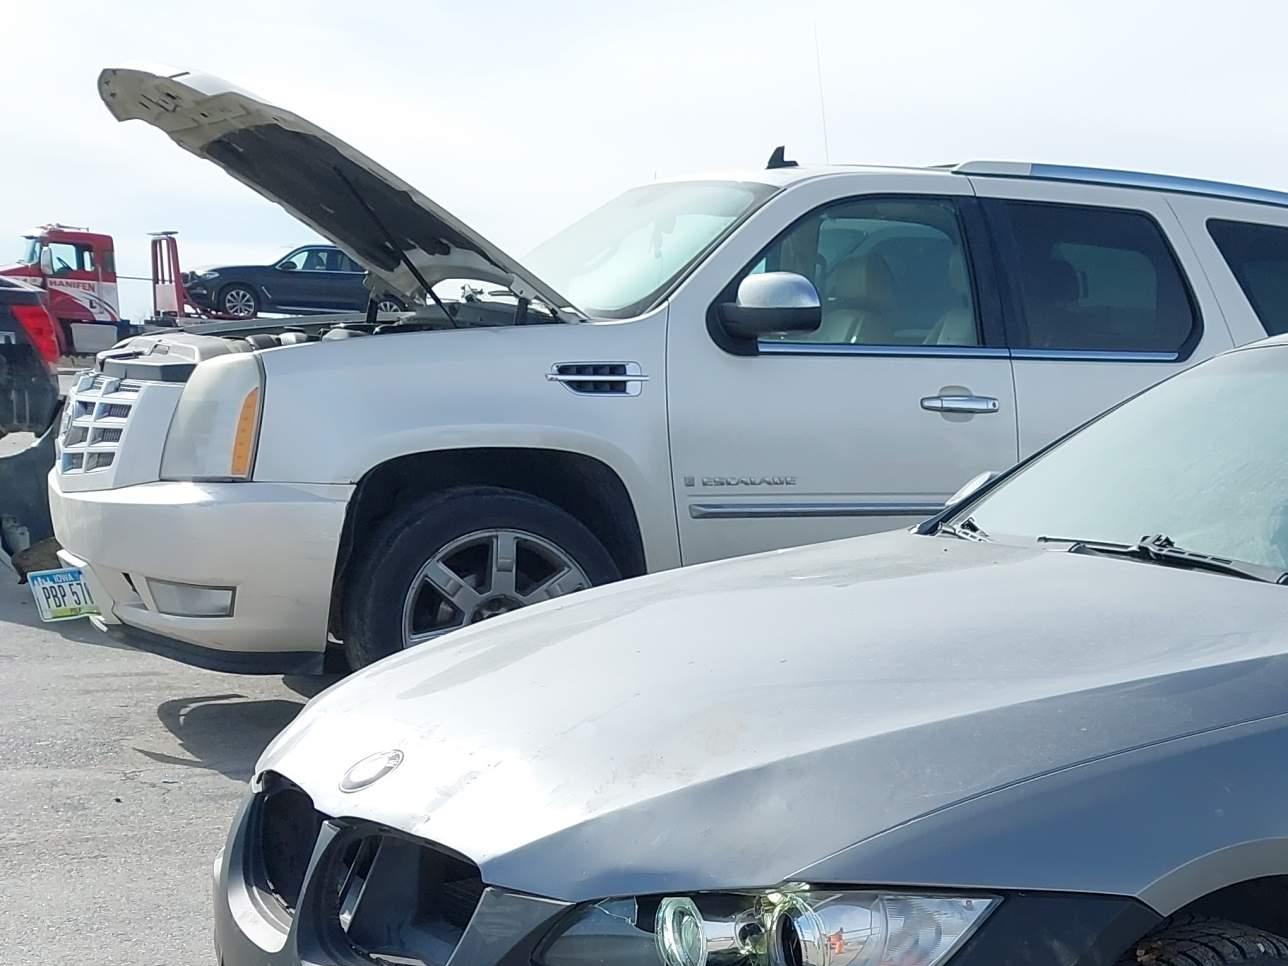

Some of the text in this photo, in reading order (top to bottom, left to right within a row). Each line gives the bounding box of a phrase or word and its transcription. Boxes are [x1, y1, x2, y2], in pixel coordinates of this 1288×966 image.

[49, 279, 96, 293] HANIFEN
[701, 476, 798, 487] ESCALADE
[42, 584, 67, 609] PBP
